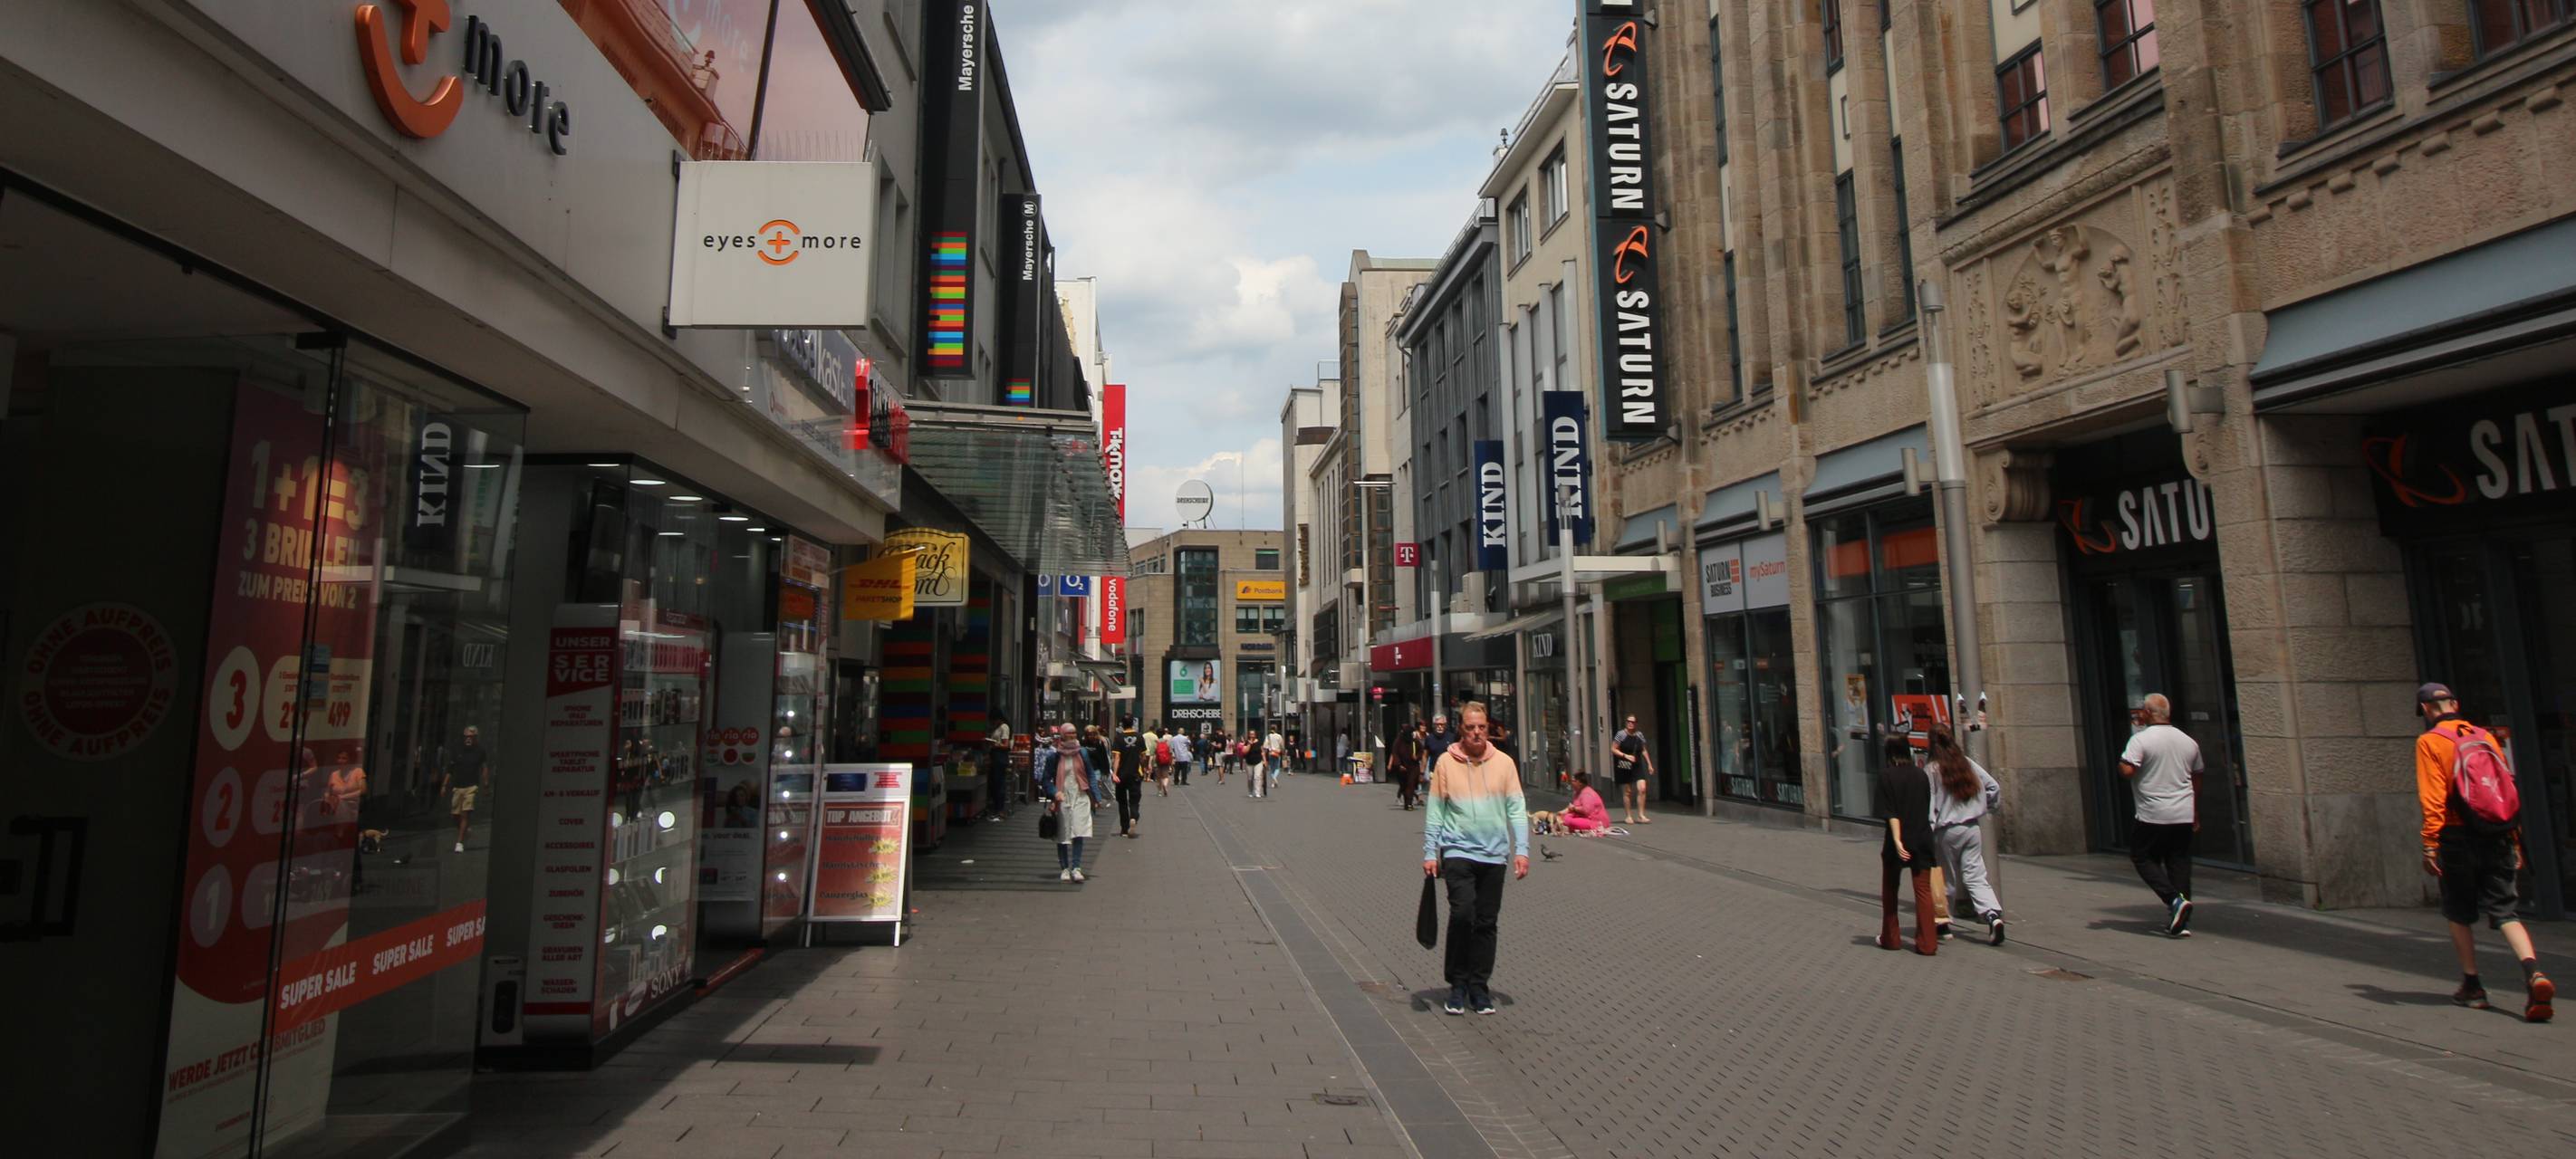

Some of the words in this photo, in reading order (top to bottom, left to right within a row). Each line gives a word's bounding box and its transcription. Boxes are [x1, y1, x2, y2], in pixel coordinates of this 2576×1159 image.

[957, 5, 976, 91] Mayersche
[464, 14, 570, 157] more
[1606, 82, 1644, 210] SATURN
[703, 235, 756, 252] eyes
[802, 234, 861, 249] more
[1023, 220, 1034, 282] Mayersche
[1616, 290, 1656, 425] SATURN
[1552, 417, 1583, 520] KIND
[2470, 404, 2576, 501] SAT
[1480, 461, 1506, 548] KIND
[237, 570, 272, 599] ZUM
[272, 572, 318, 606] PREIS
[321, 584, 345, 608] VON
[1706, 561, 1730, 583] SATURN
[1750, 561, 1785, 582] mySaturn
[1108, 579, 1119, 632] vodafone
[555, 637, 610, 649] UNSER
[1533, 633, 1553, 658] KIND
[553, 668, 610, 682] VICE
[226, 668, 247, 731] 3
[215, 783, 232, 831] 2
[372, 943, 407, 975] SUPER
[408, 934, 435, 963] SALE
[447, 919, 474, 947] SUPER
[281, 972, 323, 1011] SUPER
[324, 961, 358, 993] SALE
[651, 963, 681, 1000] SONY
[168, 1057, 211, 1093] WERDE
[213, 1046, 249, 1075] JETZT
